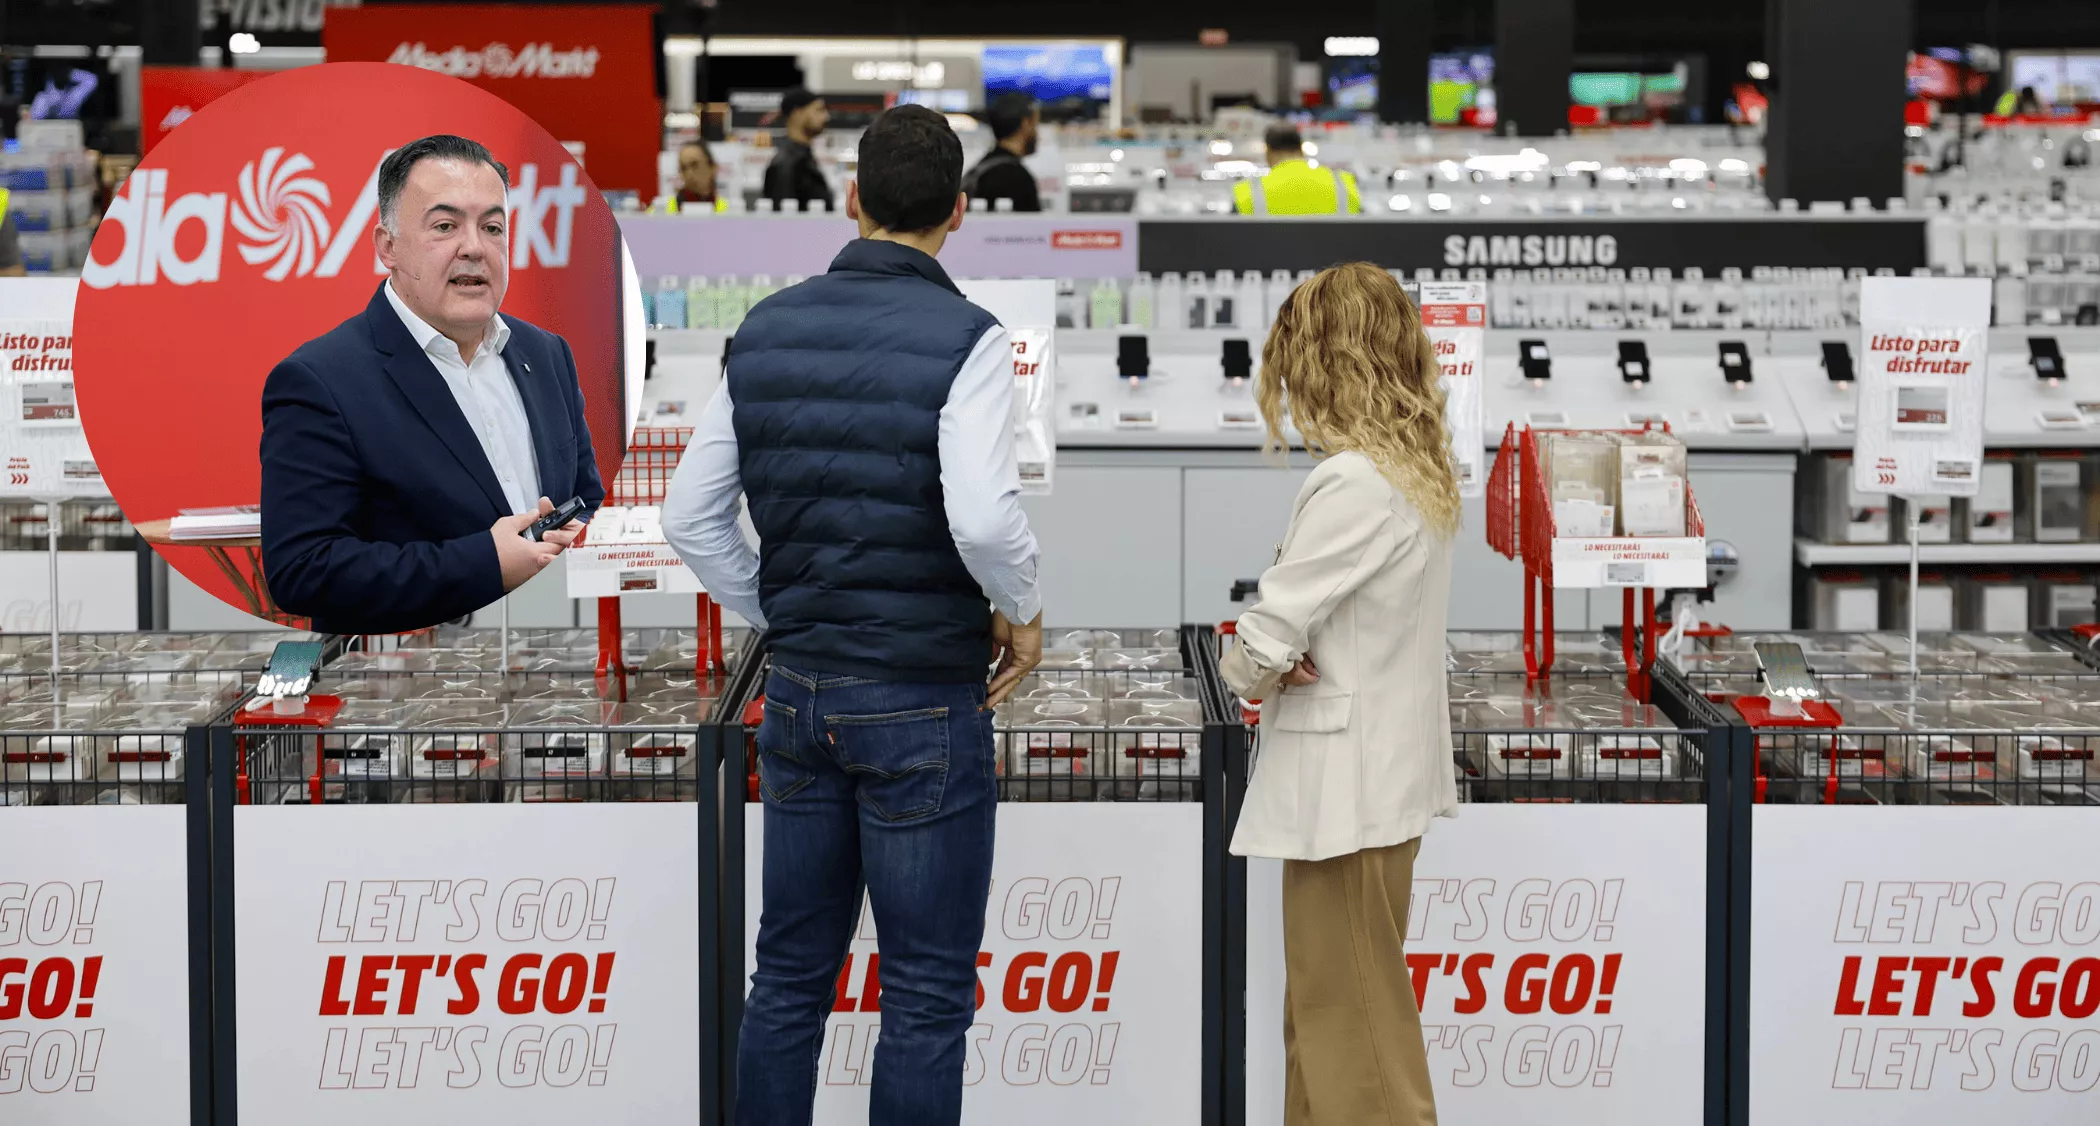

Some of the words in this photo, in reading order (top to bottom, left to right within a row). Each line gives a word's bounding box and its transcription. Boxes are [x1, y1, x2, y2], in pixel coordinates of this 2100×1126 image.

[1443, 234, 1618, 266] SAMSUNG
[12, 353, 74, 372] disfru
[1013, 360, 1039, 376] tar
[1460, 360, 1474, 376] ti
[1870, 334, 1915, 352] Listo
[1916, 339, 1961, 355] para
[1886, 355, 1972, 375] disfrutar
[597, 552, 607, 561] LO
[608, 551, 655, 560] NECESITARÁS
[636, 558, 683, 568] NECESITARÁS
[1584, 543, 1594, 551] LO
[1595, 543, 1641, 551] NECESITARÁS
[1612, 552, 1622, 560] LO
[1623, 552, 1670, 560] NECESITARÁS
[0, 879, 104, 947] GO!
[317, 878, 488, 943] LET'S
[495, 876, 617, 942] GO!
[1001, 875, 1122, 941] GO!
[1503, 877, 1625, 943] GO!
[1833, 881, 2007, 945] LET'S
[2013, 881, 2100, 946] GO
[0, 954, 104, 1021] GO!
[318, 952, 488, 1016] LET'S
[496, 951, 617, 1016] GO!
[1001, 950, 1121, 1014] GO!
[1503, 952, 1624, 1016] GO!
[1833, 955, 2005, 1018] LET'S
[2012, 955, 2100, 1019] GO
[0, 1027, 106, 1095] GO!
[318, 1024, 489, 1090] LET'S
[496, 1022, 618, 1089] GO!
[1001, 1021, 1122, 1087] GO!
[1502, 1024, 1624, 1089] GO!
[1831, 1026, 2005, 1092] LET'S
[2011, 1027, 2100, 1093] GO
